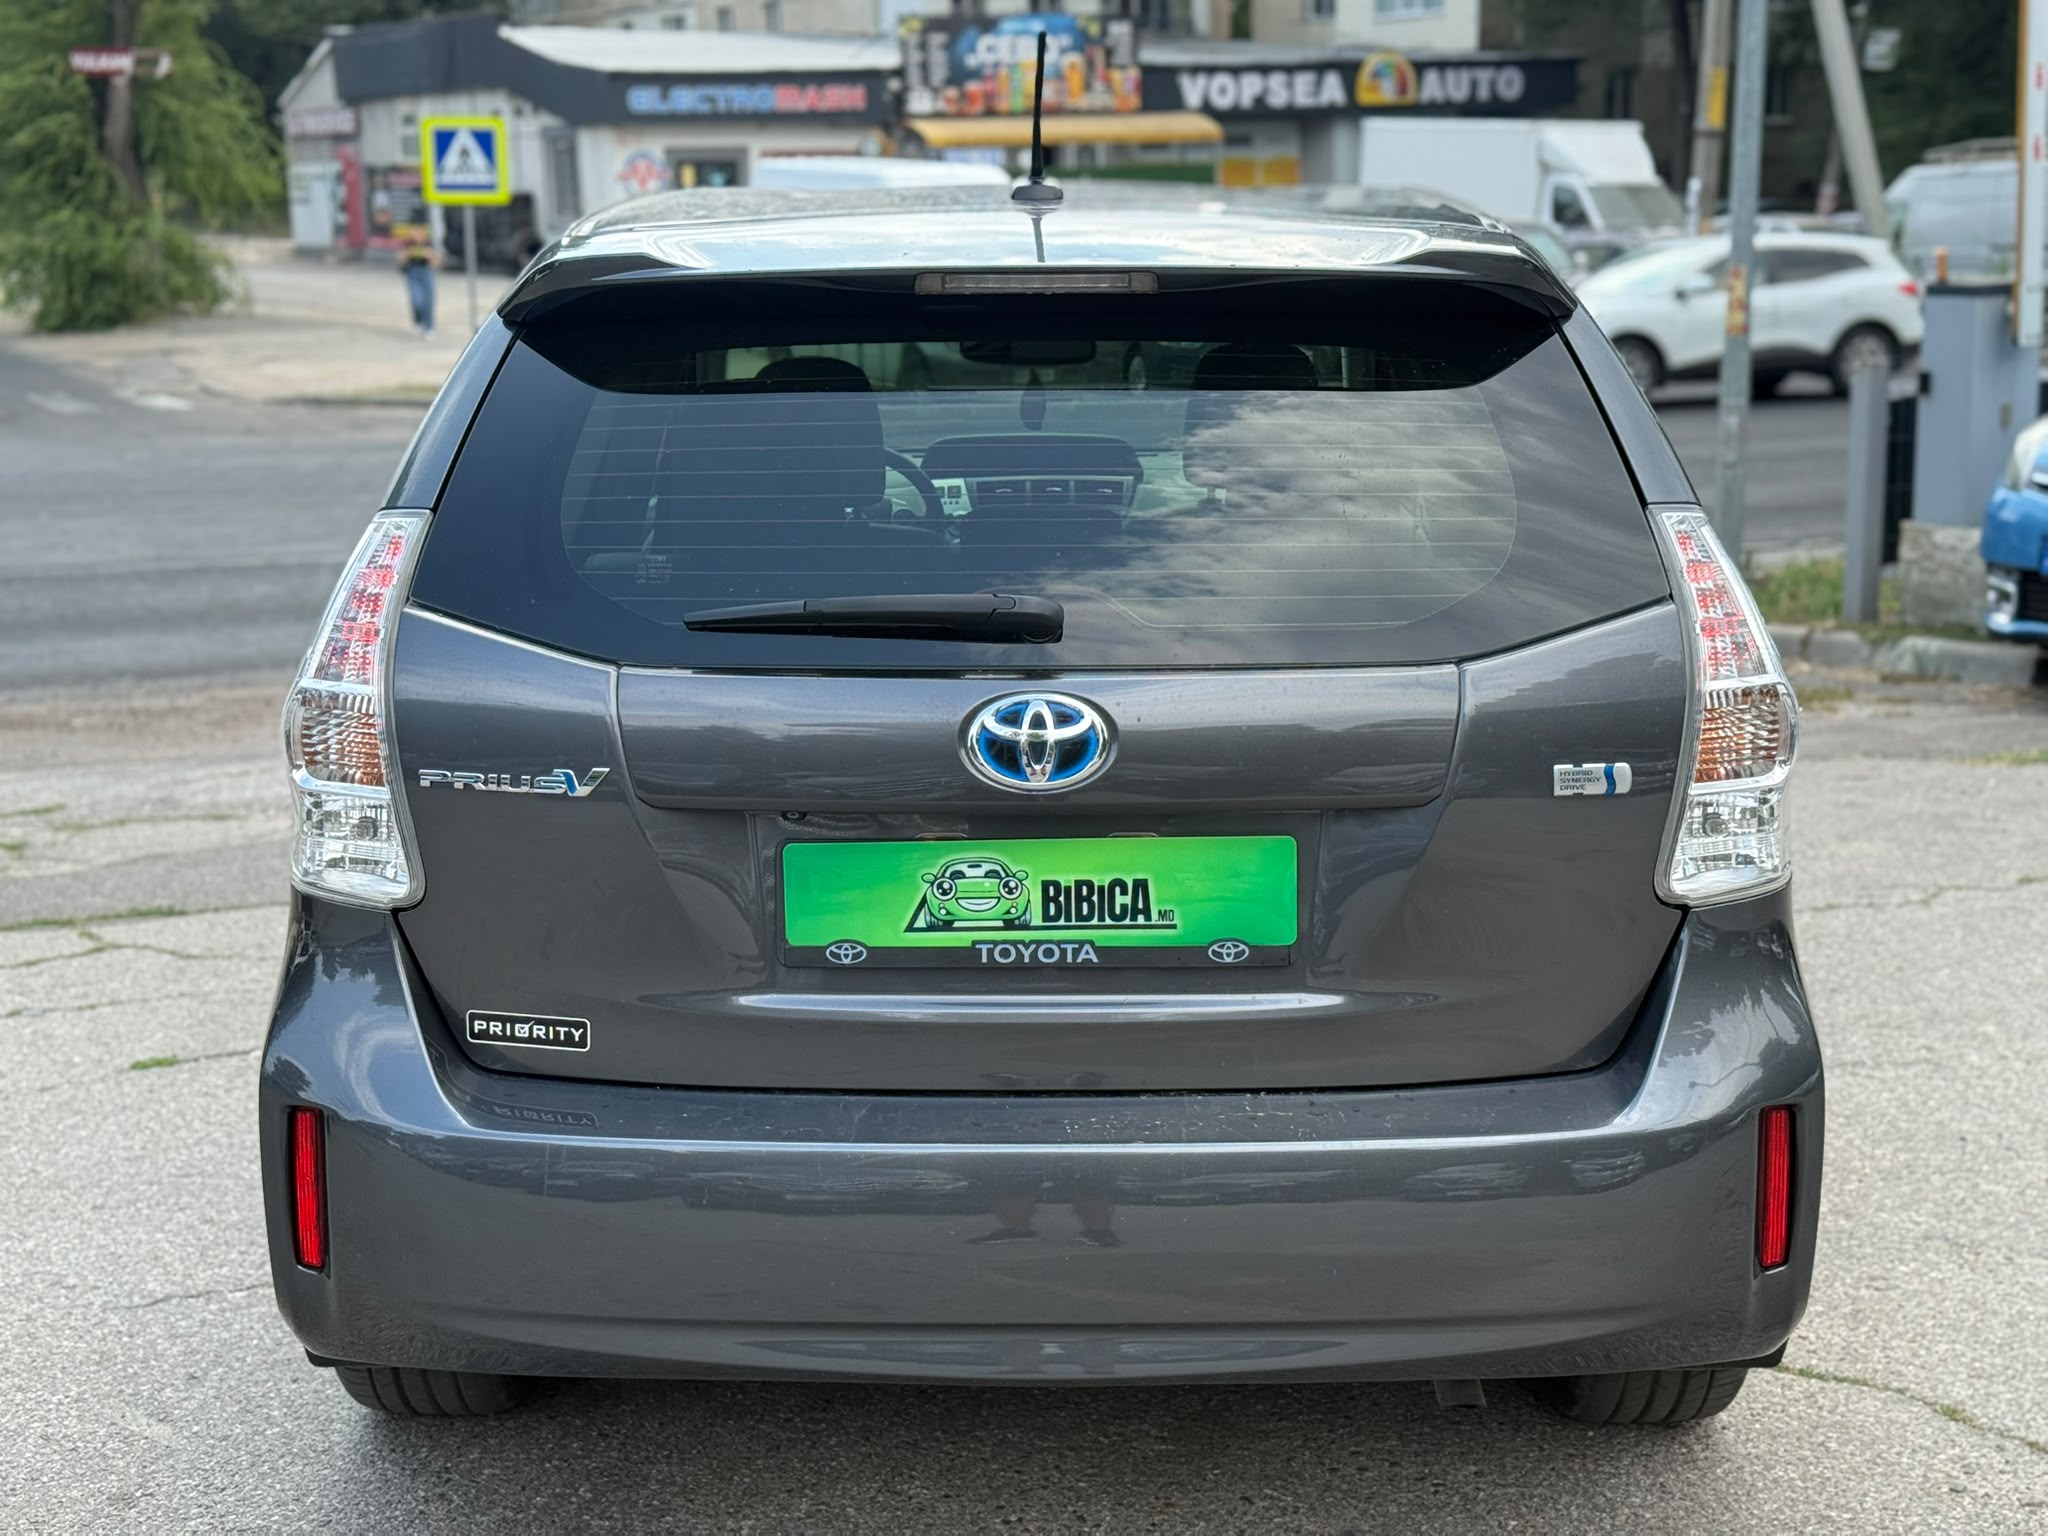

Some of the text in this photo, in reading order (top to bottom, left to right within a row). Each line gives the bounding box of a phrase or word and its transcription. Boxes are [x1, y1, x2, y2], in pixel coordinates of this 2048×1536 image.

[1176, 66, 1525, 110] VOPSEA AUTO
[1559, 769, 1593, 777] HYBRID
[1559, 776, 1601, 784] SYNERGY
[975, 943, 1099, 964] TOYOTA
[474, 1020, 584, 1042] PRIORITY
